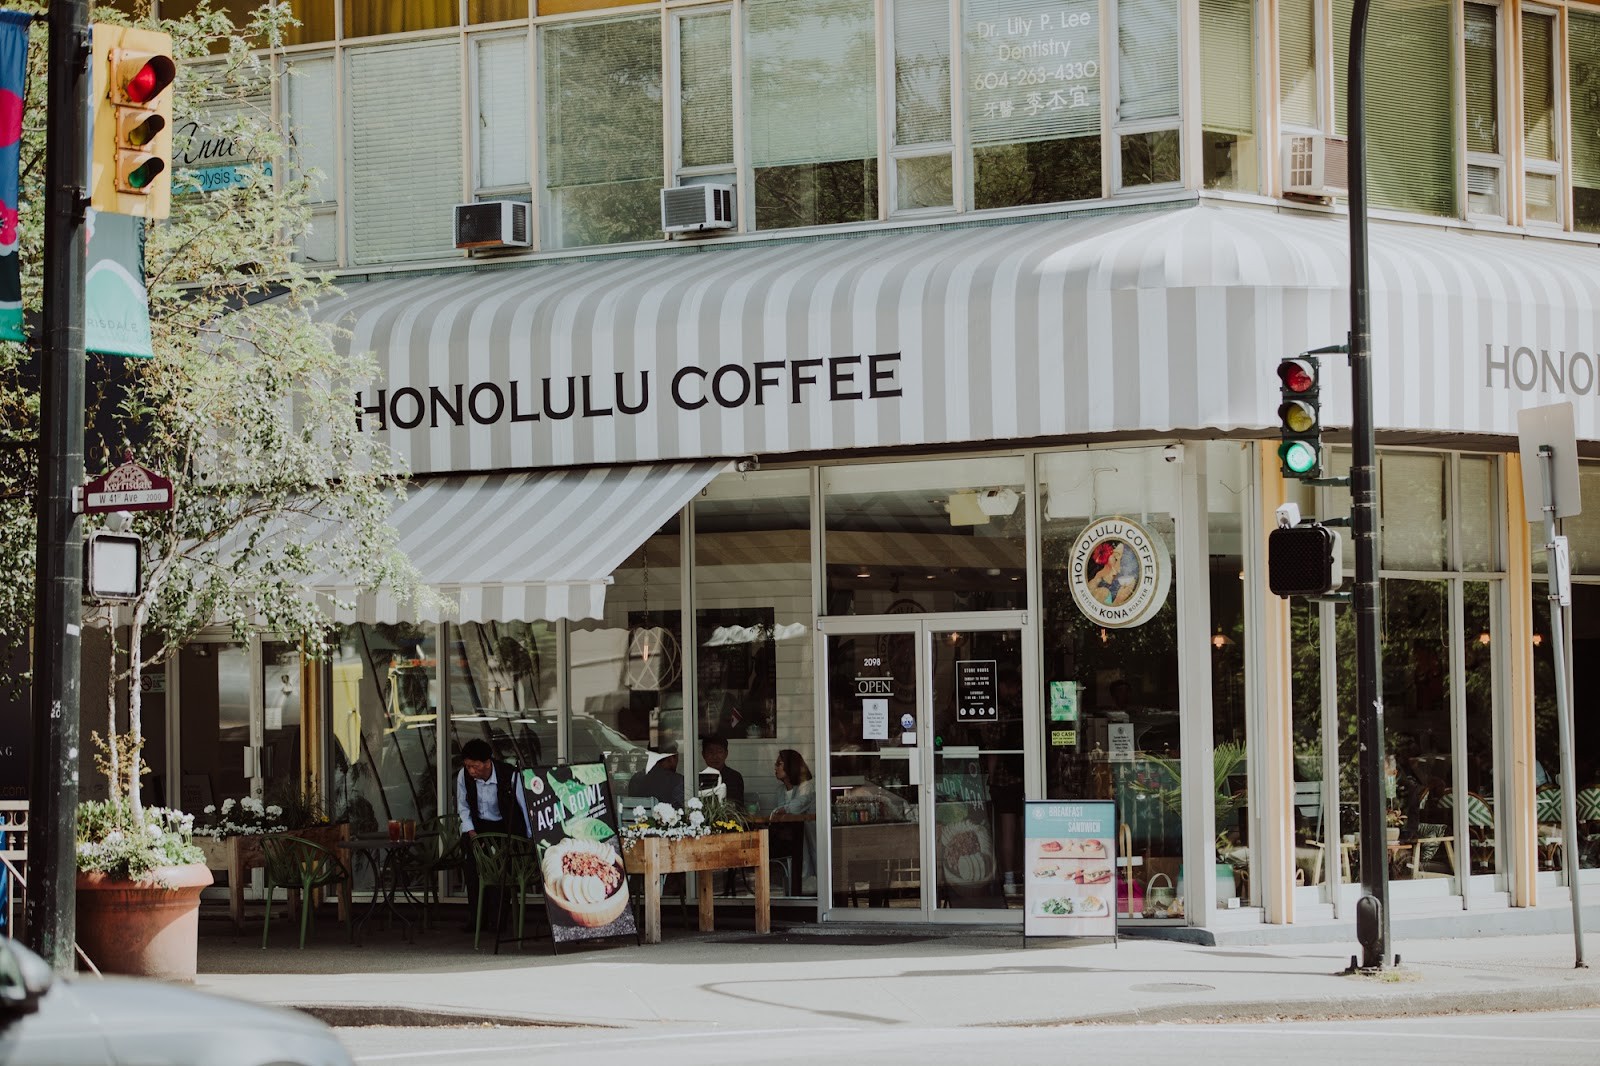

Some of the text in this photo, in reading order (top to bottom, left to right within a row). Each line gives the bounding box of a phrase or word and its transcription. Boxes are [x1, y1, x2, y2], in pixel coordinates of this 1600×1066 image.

[978, 11, 1091, 39] Dr. Lily P. Lee
[1000, 40, 1071, 61] Dentistry
[975, 61, 1097, 90] 604-263-4330
[1485, 343, 1600, 396] HONO
[354, 351, 904, 432] HONOLULU COFFEE
[104, 480, 153, 492] Kerrisdale
[99, 493, 162, 504] W 41 Ave 2000
[1074, 524, 1154, 586] HONOLULU COFFEE
[1099, 608, 1129, 619] KONA
[863, 657, 881, 667] 2098
[858, 680, 891, 693] OPEN
[568, 784, 604, 814] BOWL
[1048, 806, 1084, 817] BREAKFAST
[1068, 821, 1101, 833] SANDWICH
